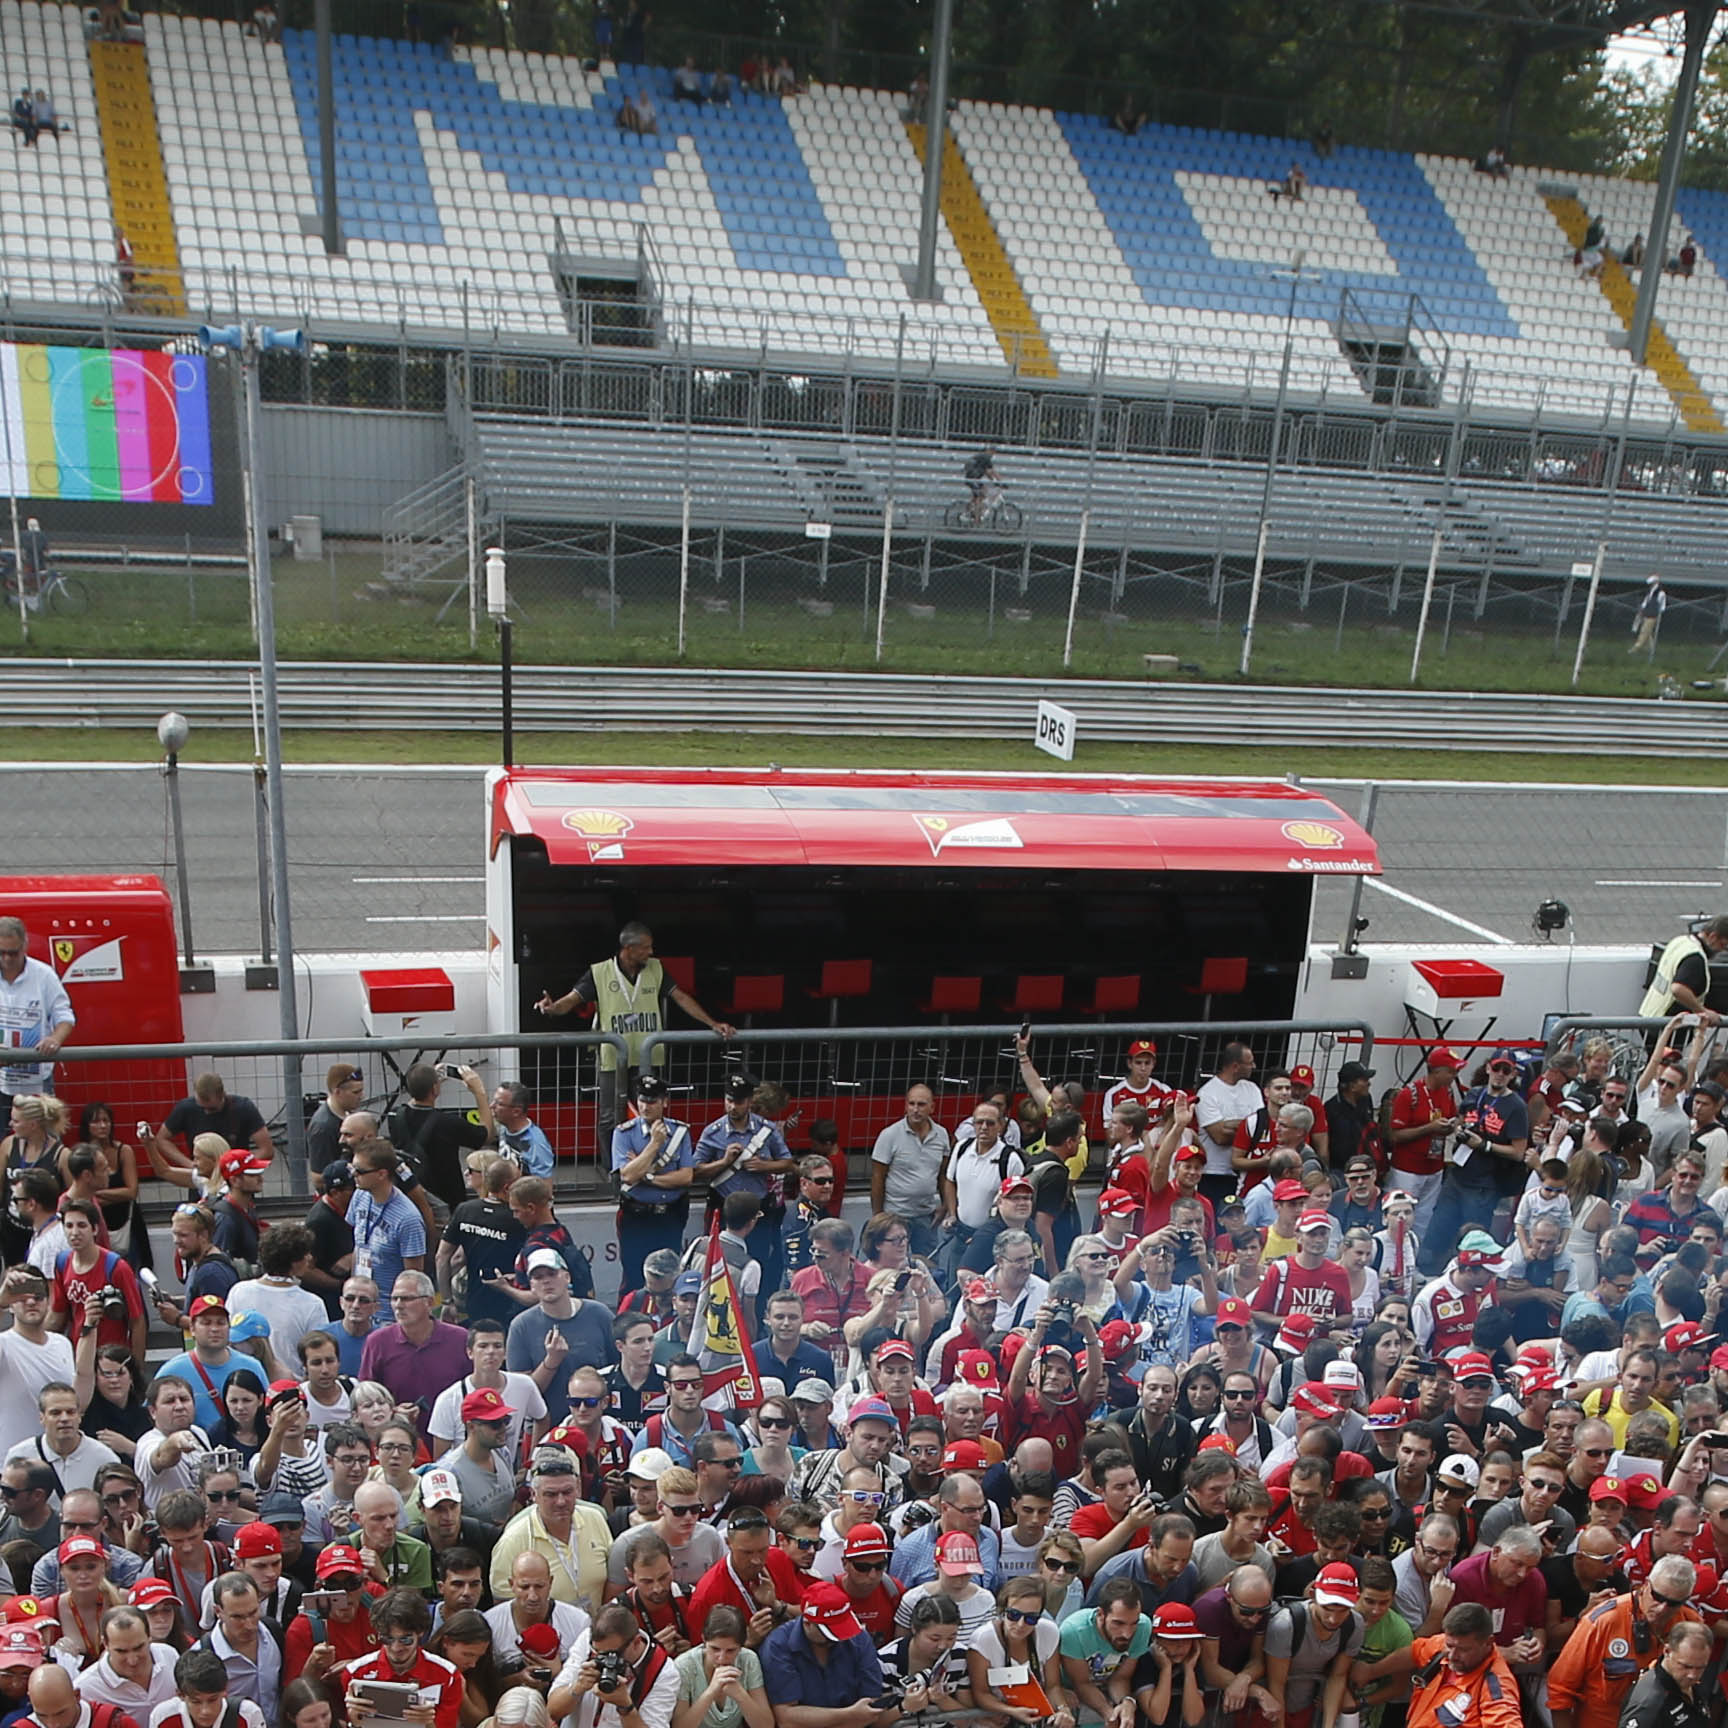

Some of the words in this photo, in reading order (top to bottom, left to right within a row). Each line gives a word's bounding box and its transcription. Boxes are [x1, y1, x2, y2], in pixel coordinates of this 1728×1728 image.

[1040, 715, 1065, 747] DRS
[1302, 858, 1375, 872] Santander
[460, 1222, 508, 1241] PETRONAS
[1292, 1283, 1335, 1306] NIKE
